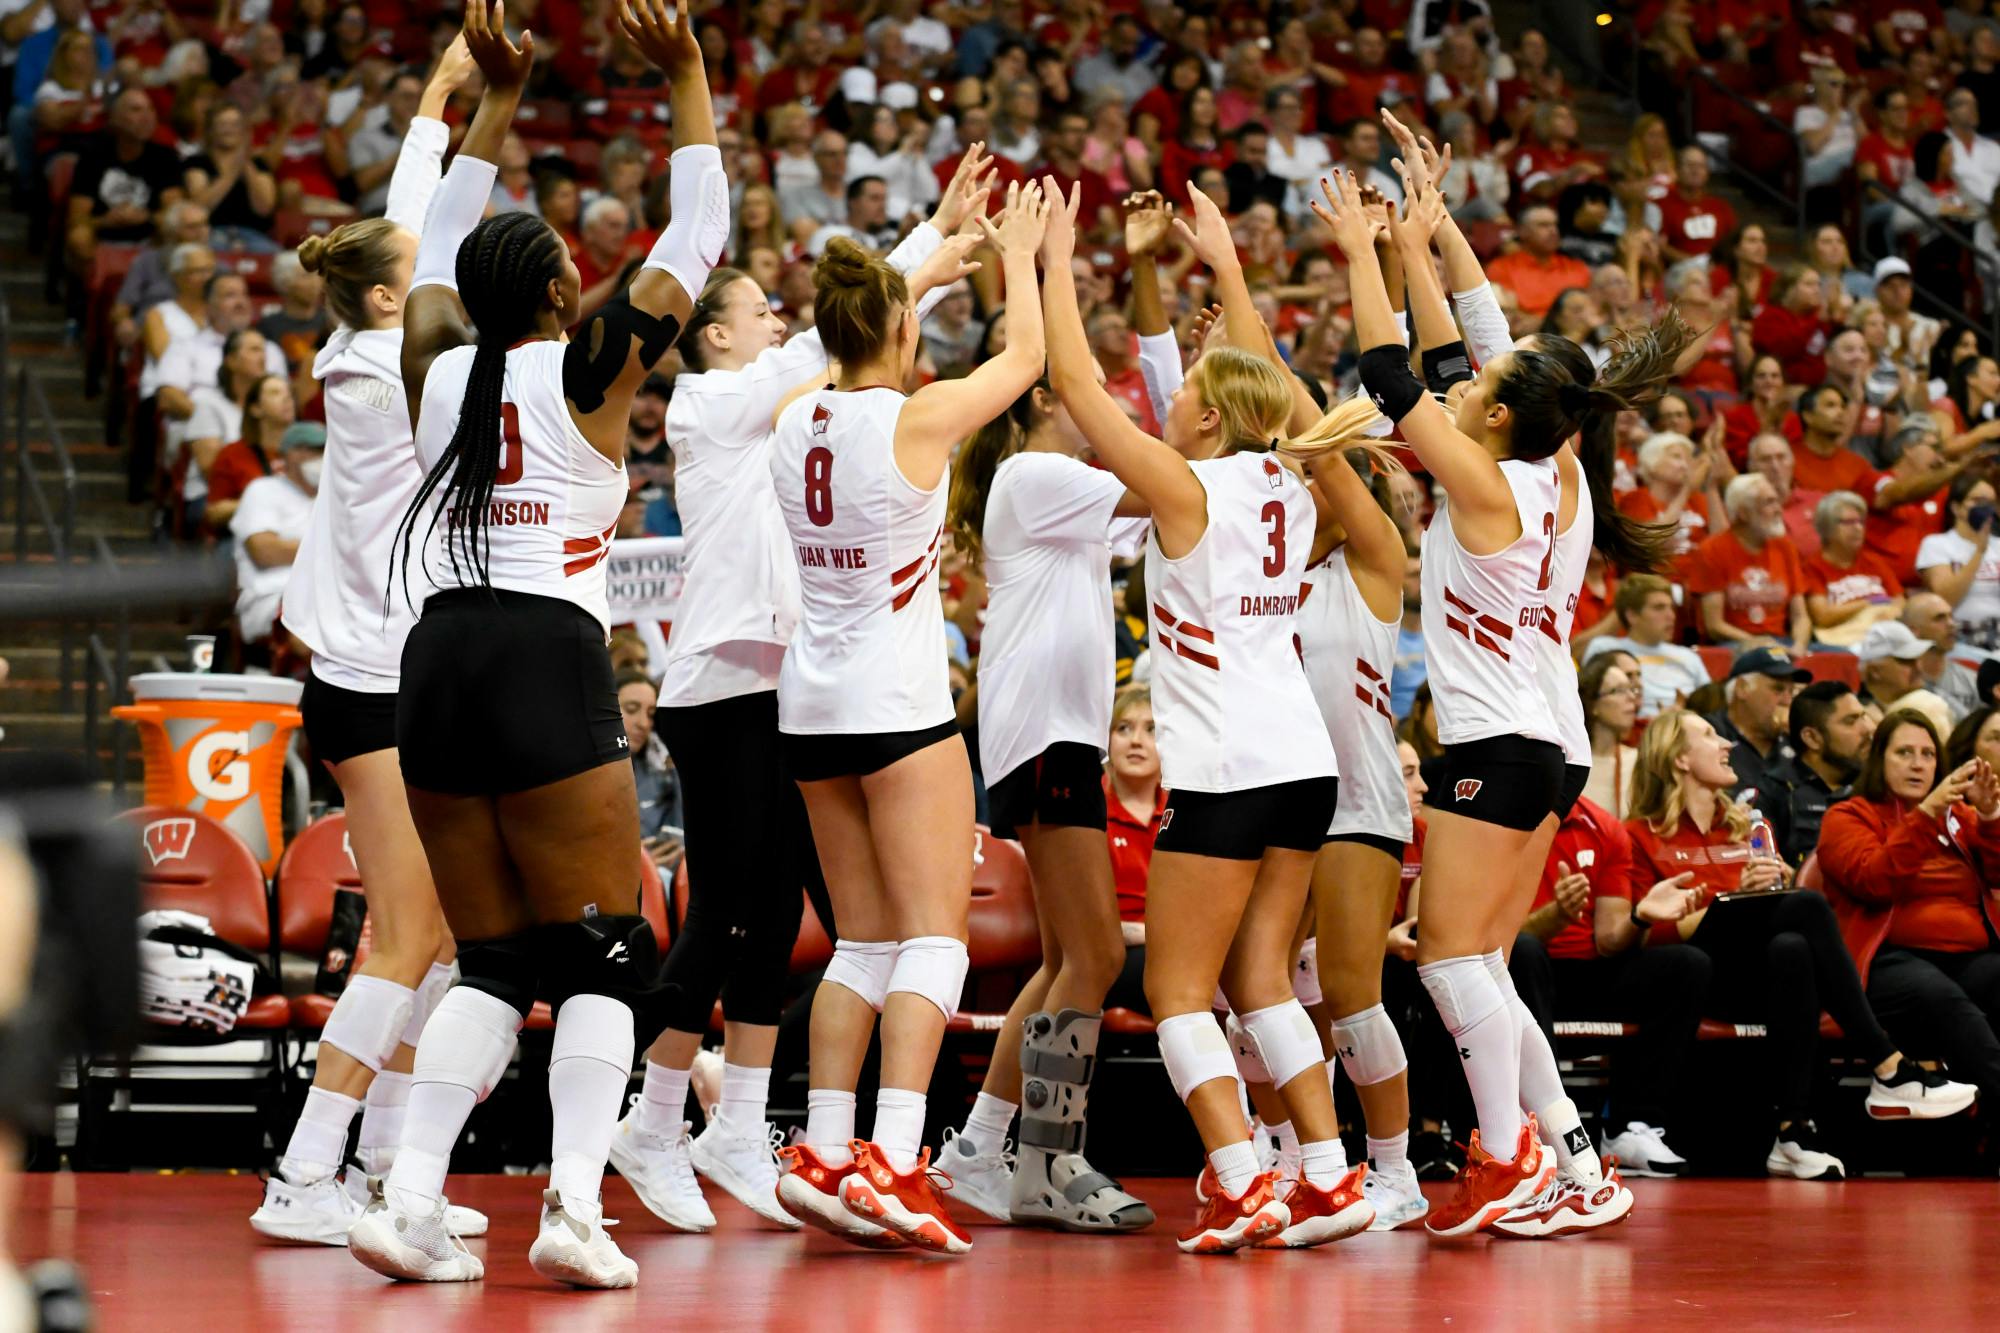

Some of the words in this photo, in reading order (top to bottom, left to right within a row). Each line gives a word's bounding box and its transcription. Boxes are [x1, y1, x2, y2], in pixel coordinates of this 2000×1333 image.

[804, 446, 834, 528] 8
[446, 502, 550, 531] RONSON
[1260, 500, 1286, 579] 3
[798, 545, 828, 569] VAN
[829, 547, 868, 570] WIE
[1239, 596, 1298, 617] DAMROW
[187, 730, 250, 801] G
[1453, 778, 1483, 803] W
[143, 817, 197, 867] W
[1552, 1021, 1624, 1036] WISCONSIN
